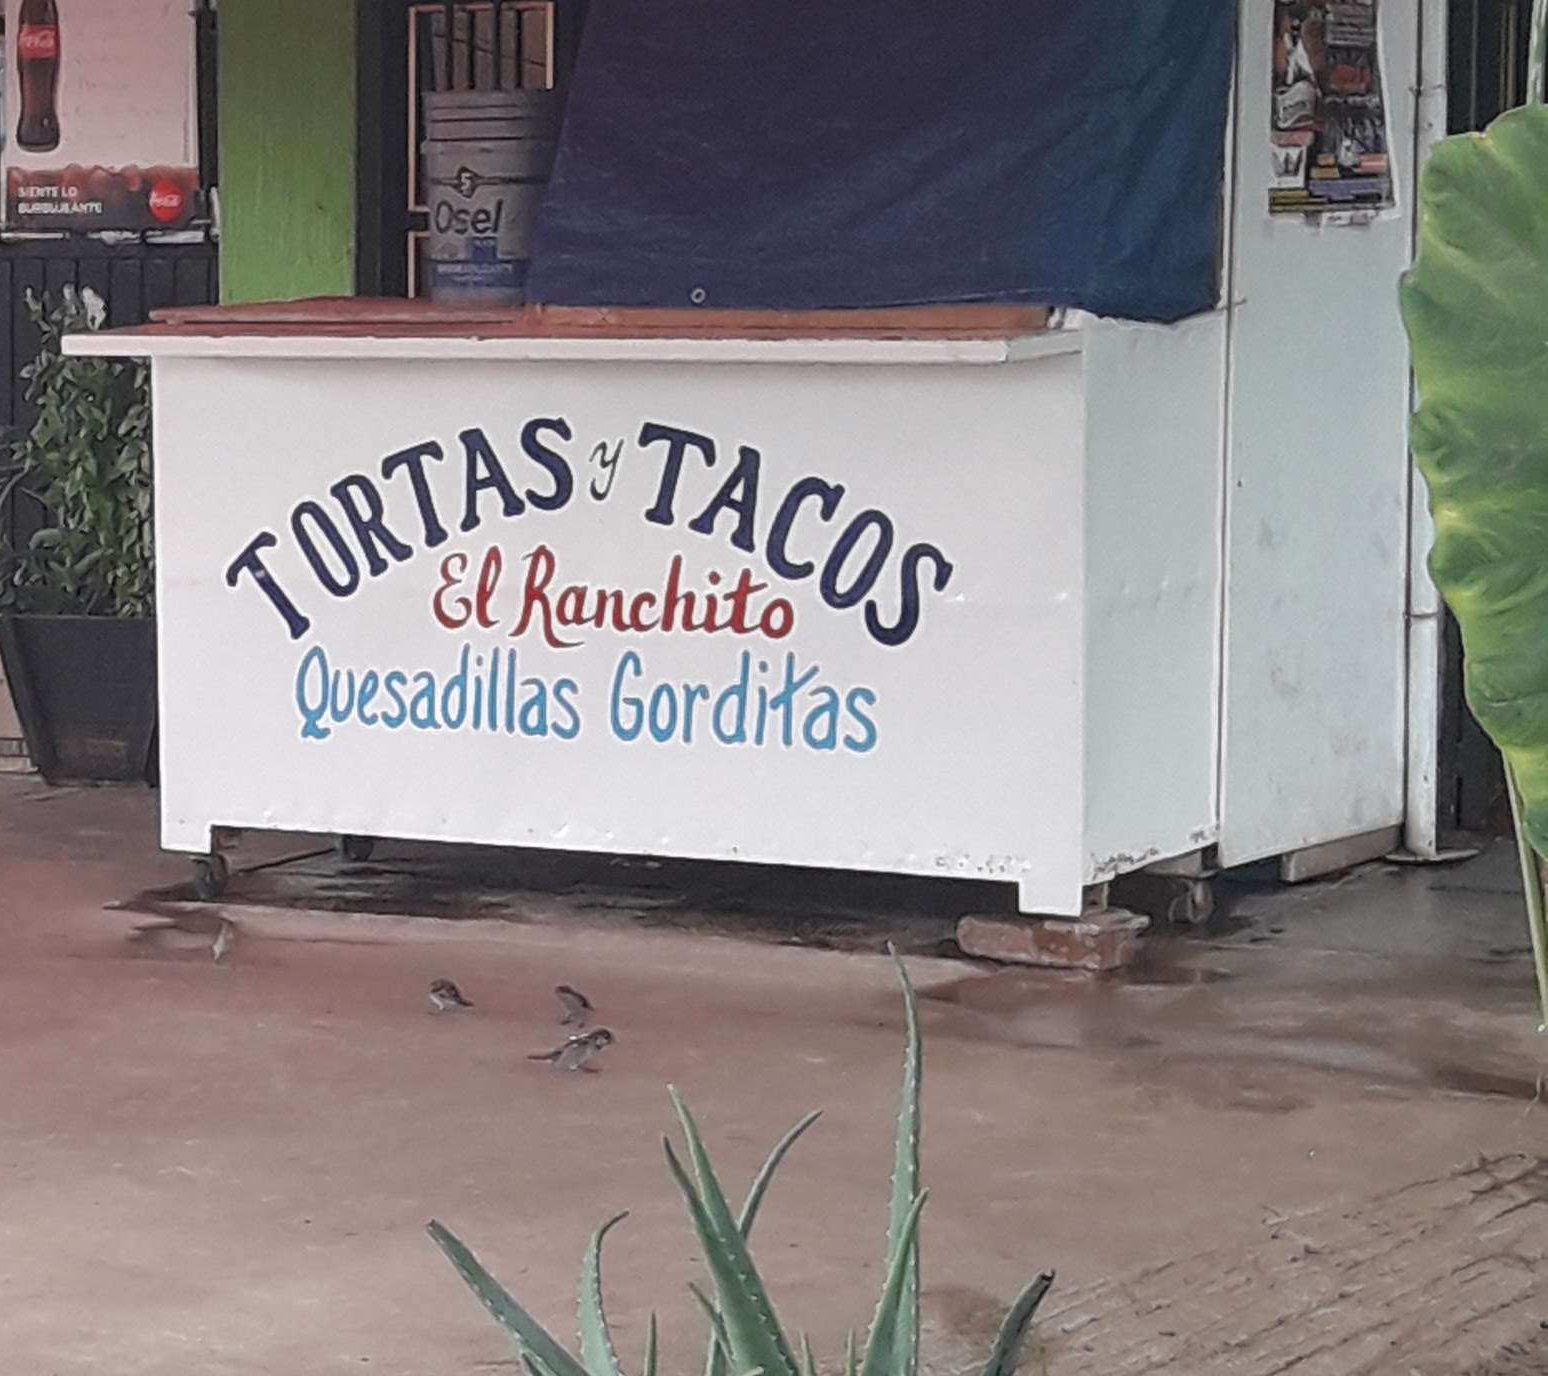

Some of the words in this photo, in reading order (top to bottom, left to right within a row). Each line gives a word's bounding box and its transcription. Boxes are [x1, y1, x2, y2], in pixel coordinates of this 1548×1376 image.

[434, 198, 504, 235] Osel
[225, 417, 573, 641] TORTAS
[589, 436, 624, 501] y
[638, 422, 953, 647] TACOS
[434, 547, 500, 632] El
[510, 544, 794, 648] Ranchito
[295, 644, 581, 741] Quesadillas
[610, 650, 879, 753] Gorditas
